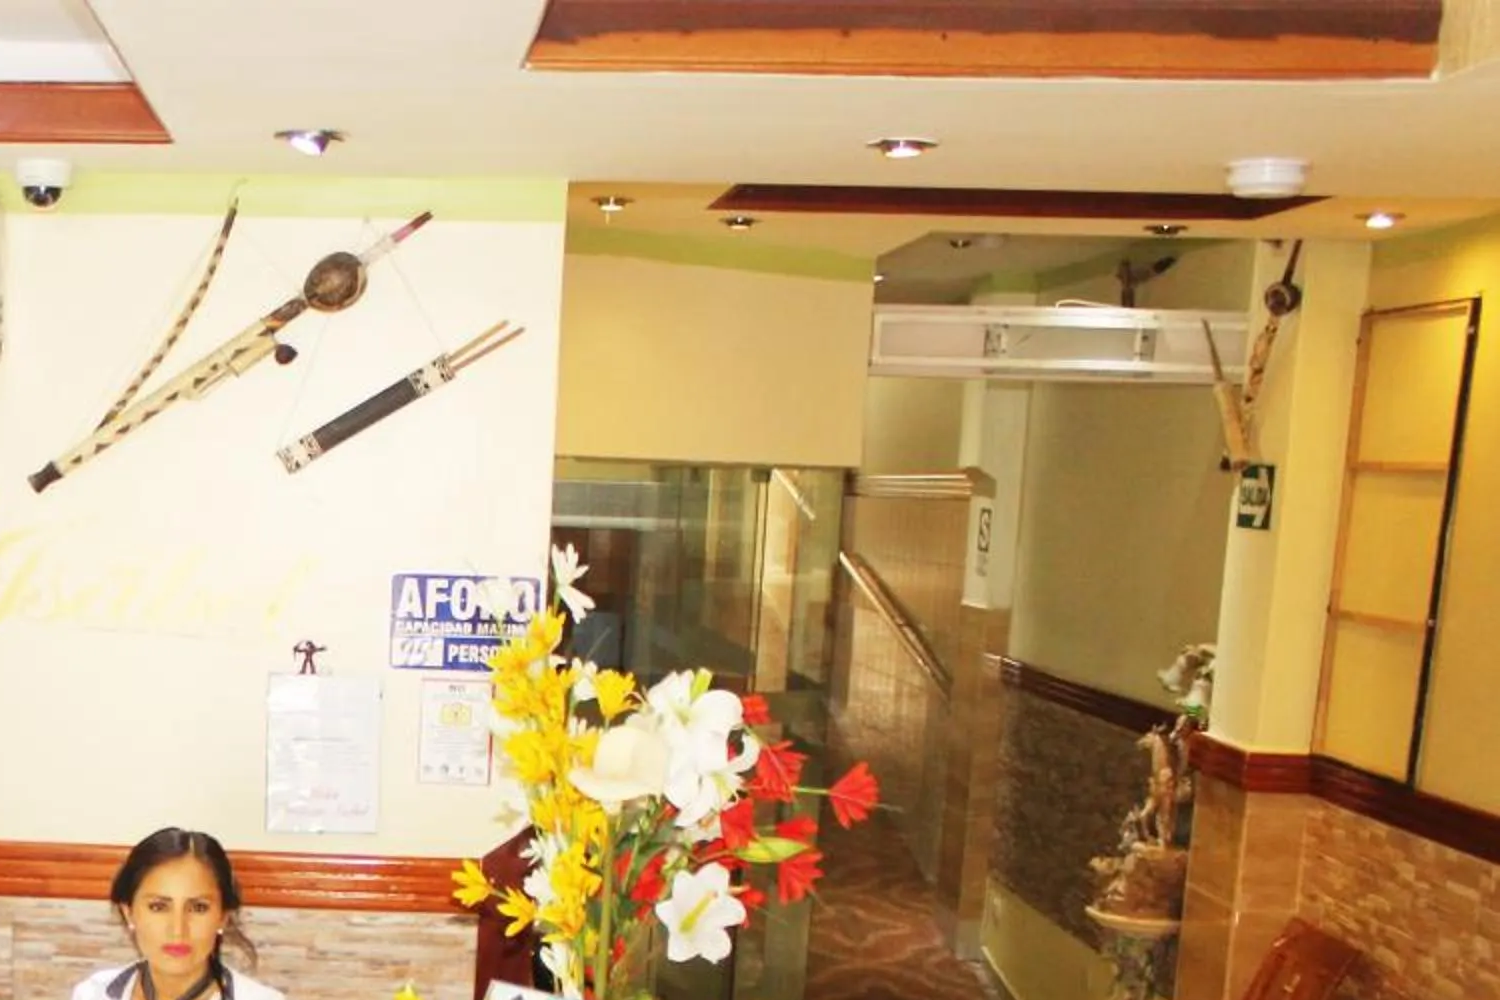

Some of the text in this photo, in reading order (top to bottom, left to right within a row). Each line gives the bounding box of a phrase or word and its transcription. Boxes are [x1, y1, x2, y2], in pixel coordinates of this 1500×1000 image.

[395, 620, 528, 637] CAPACIDAD MAIM
[447, 643, 498, 665] PERSO
